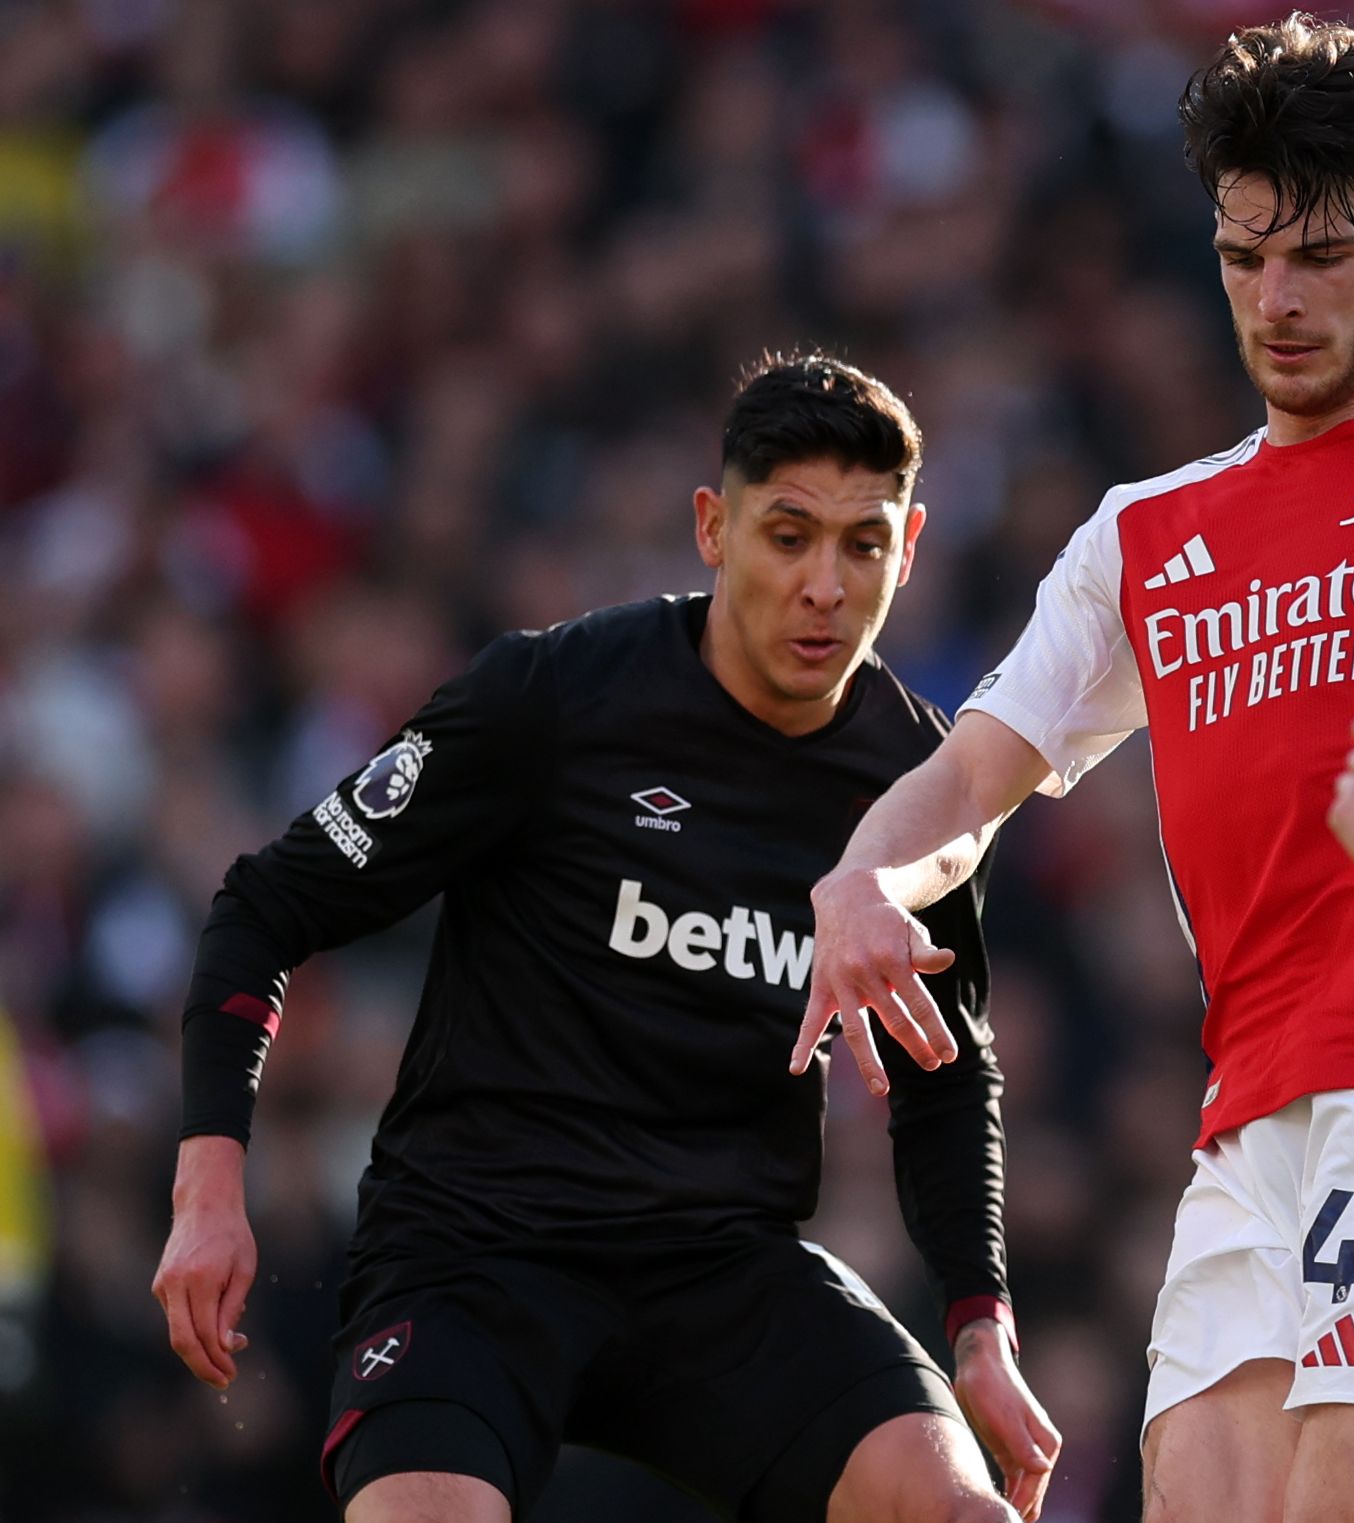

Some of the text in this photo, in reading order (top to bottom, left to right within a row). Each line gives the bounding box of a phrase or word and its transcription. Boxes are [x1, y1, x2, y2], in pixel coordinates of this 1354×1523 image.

[1188, 662, 1240, 732] FLY
[312, 803, 368, 869] for racism
[324, 790, 373, 852] No room
[634, 814, 682, 832] umbro
